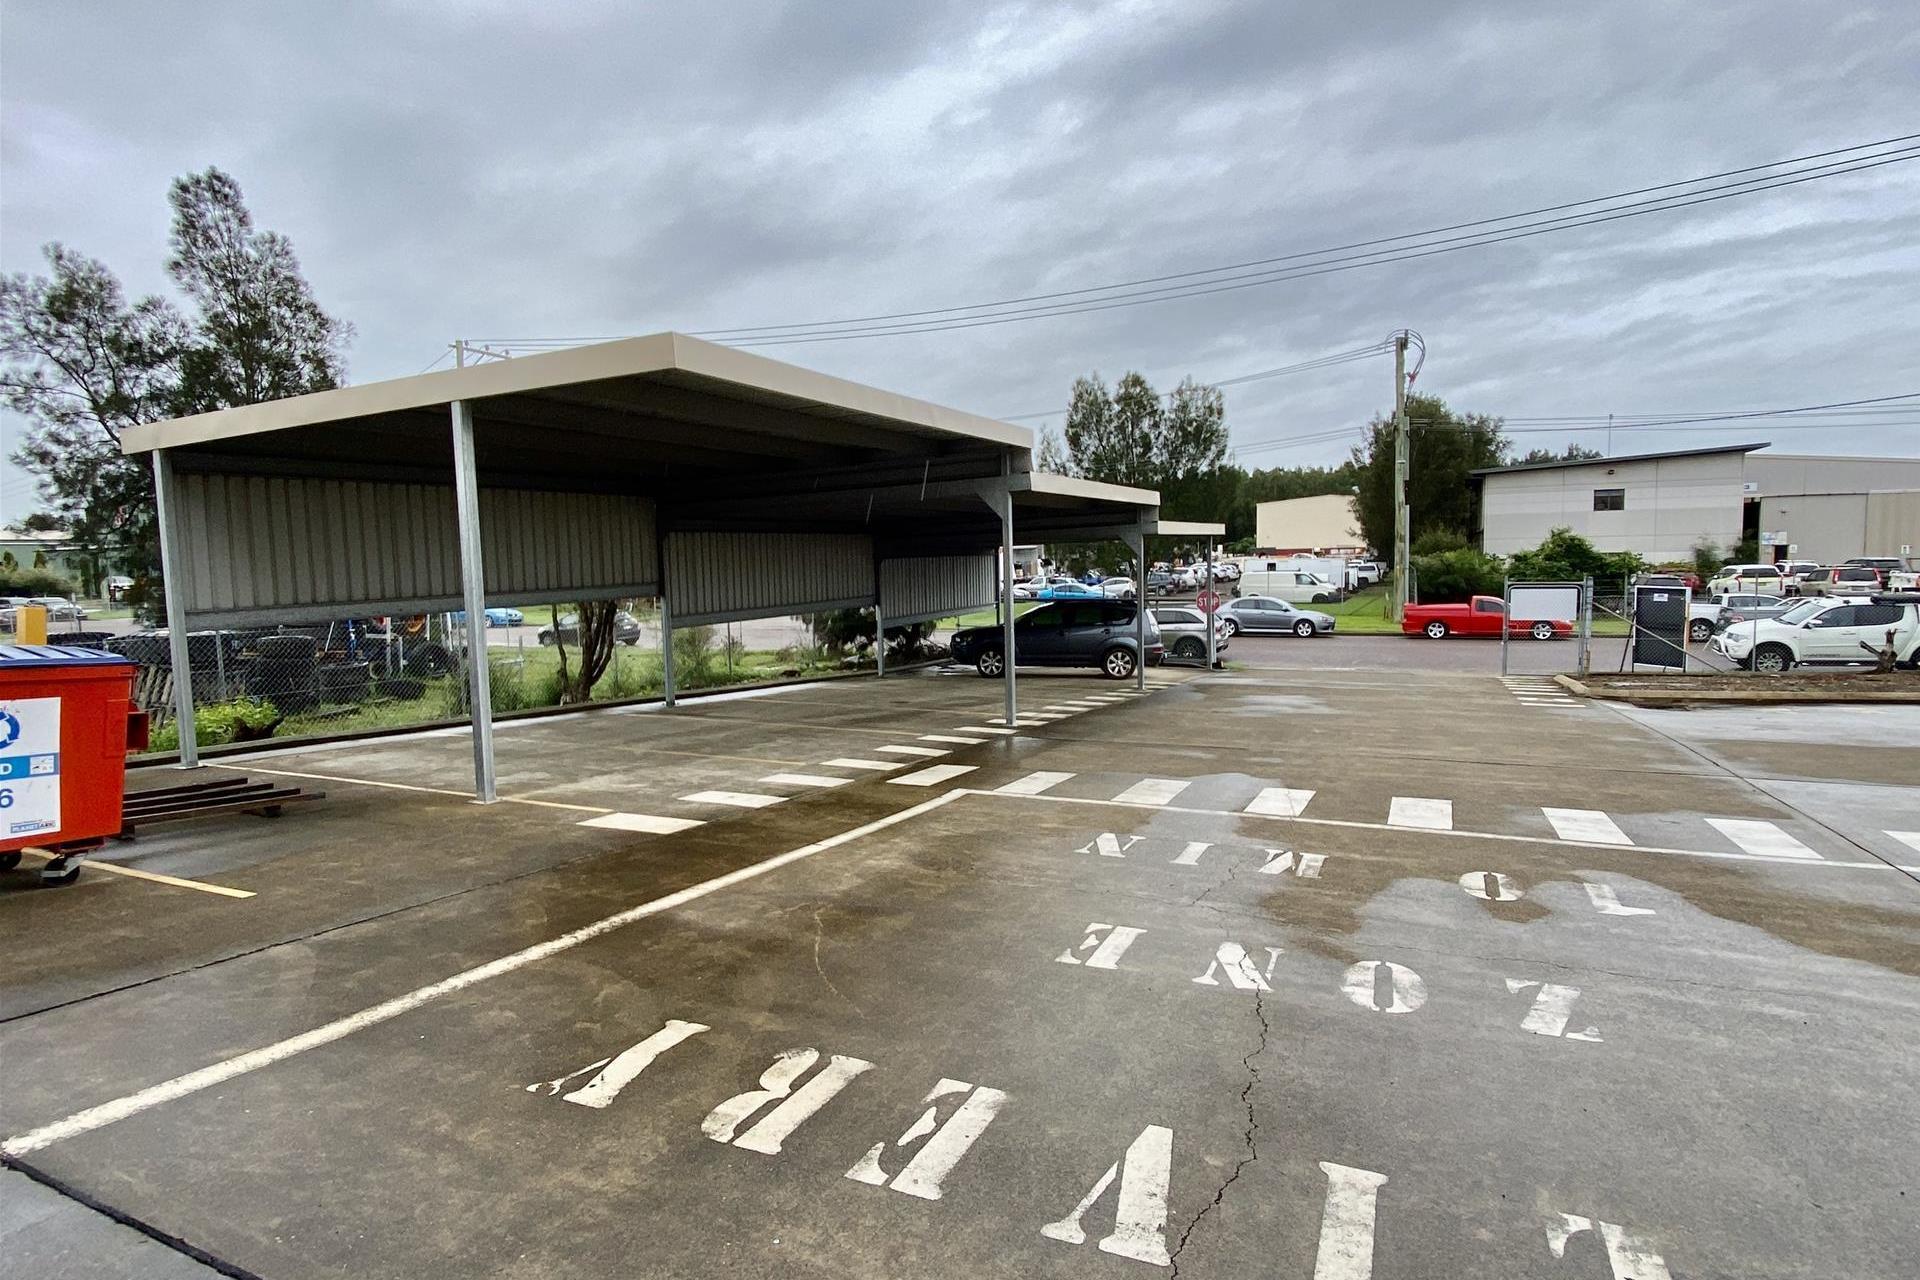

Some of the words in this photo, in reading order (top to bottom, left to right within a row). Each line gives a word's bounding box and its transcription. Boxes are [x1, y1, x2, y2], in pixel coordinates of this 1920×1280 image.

[1198, 596, 1219, 607] STP
[1074, 832, 1330, 879] MIN
[1055, 922, 1605, 1043] ZONE
